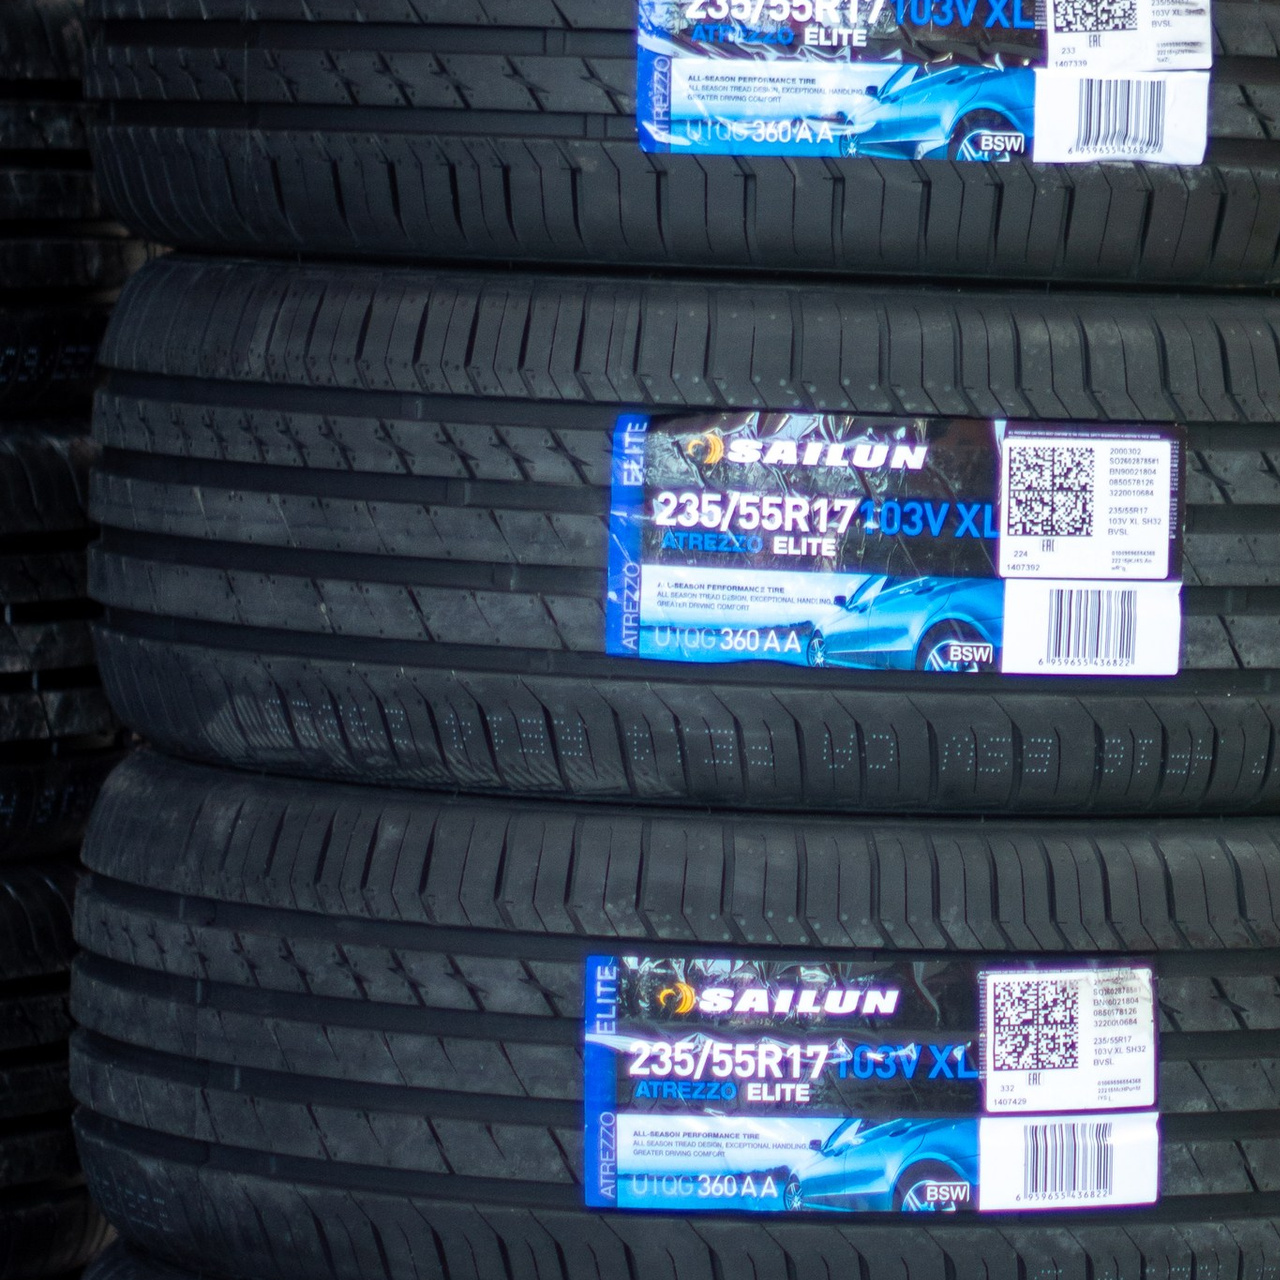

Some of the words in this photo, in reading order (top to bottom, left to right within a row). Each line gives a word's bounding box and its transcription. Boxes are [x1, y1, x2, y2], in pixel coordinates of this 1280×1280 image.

[803, 26, 868, 48] ELITE
[1054, 59, 1088, 69] 1407339
[751, 118, 792, 144] 360
[980, 135, 1022, 152] BSW
[727, 438, 928, 470] SAILUN
[1109, 447, 1142, 456] 2000302
[1109, 467, 1157, 476] BN90021804
[1108, 478, 1155, 487] 0850578126
[1109, 488, 1155, 497] 3220010684
[654, 490, 862, 535] 235/55R17
[860, 500, 950, 538] 103V
[954, 503, 1000, 539] XL
[1108, 506, 1149, 516] 235/55R17
[1108, 517, 1127, 526] 103V
[1141, 517, 1163, 526] SH32
[1107, 527, 1130, 537] BVSL
[661, 531, 763, 554] ATREZZO
[773, 536, 838, 557] ELITE
[1013, 550, 1029, 559] 224
[1006, 563, 1041, 572] 1407392
[622, 562, 641, 650] ATREZZO
[719, 626, 760, 652] 360
[949, 645, 991, 662] BSW
[1050, 657, 1089, 667] 959655
[1093, 657, 1131, 667] 436822
[596, 965, 618, 1035] ELITE
[699, 988, 900, 1014] SAILUN
[1093, 1036, 1132, 1045] 235/55R17
[1094, 1047, 1113, 1056] 103V
[1126, 1045, 1147, 1054] SH32
[628, 1039, 830, 1080] 235/55R17
[837, 1044, 923, 1080] 103V
[927, 1045, 979, 1079] XL
[1093, 1058, 1115, 1066] BVSL
[635, 1081, 738, 1101] ATREZZO
[747, 1083, 811, 1102] ELITE
[999, 1084, 1015, 1093] 332
[993, 1097, 1027, 1106] 1407429
[633, 1130, 681, 1139] ALL-SEASON
[682, 1131, 740, 1140] PERFORMANCE
[742, 1132, 760, 1140] TIRE
[646, 1140, 673, 1148] SEASON
[674, 1140, 697, 1148] TREAD
[697, 1140, 725, 1149] DESIGN,
[725, 1141, 771, 1150] EXCEPTIONAL
[771, 1142, 809, 1151] HANDLING,
[599, 1111, 616, 1199] ATREZZO
[633, 1149, 664, 1157] GREATER
[665, 1149, 692, 1158] DRIVING
[693, 1150, 725, 1158] COMFORT
[697, 1173, 737, 1197] 360
[926, 1185, 967, 1202] BSW
